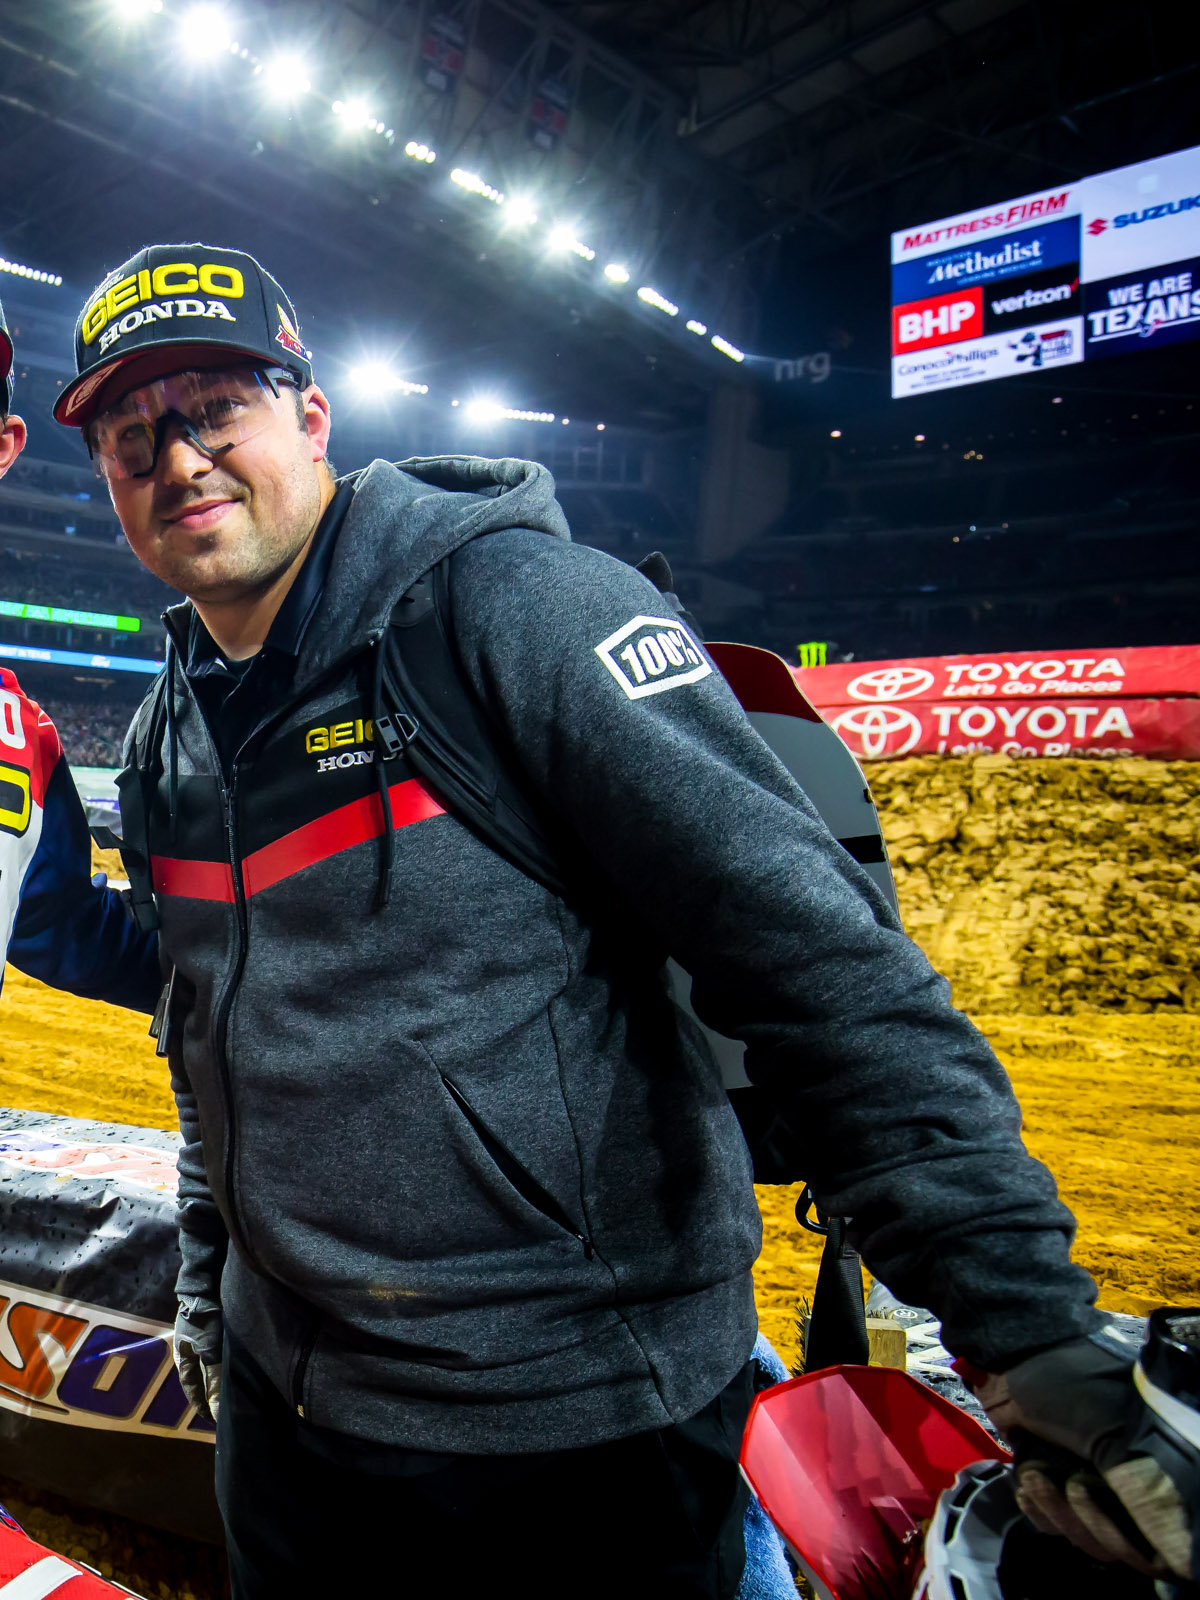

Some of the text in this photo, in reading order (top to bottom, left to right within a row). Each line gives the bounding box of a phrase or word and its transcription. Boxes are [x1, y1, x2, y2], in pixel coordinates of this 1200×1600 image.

[927, 240, 1043, 284] Methodist
[82, 263, 244, 345] GEICO
[991, 284, 1071, 315] verizon
[1108, 272, 1193, 306] WE ARE
[99, 299, 236, 354] HONDA
[898, 300, 976, 344] BHP
[1087, 289, 1200, 337] TEXANS
[773, 352, 831, 383] nrg
[620, 630, 700, 684] 100%
[944, 658, 1125, 684] TOYOTA
[942, 679, 1123, 698] Let's Go Places
[931, 706, 1134, 740] TOYOTA
[317, 749, 376, 773] HON
